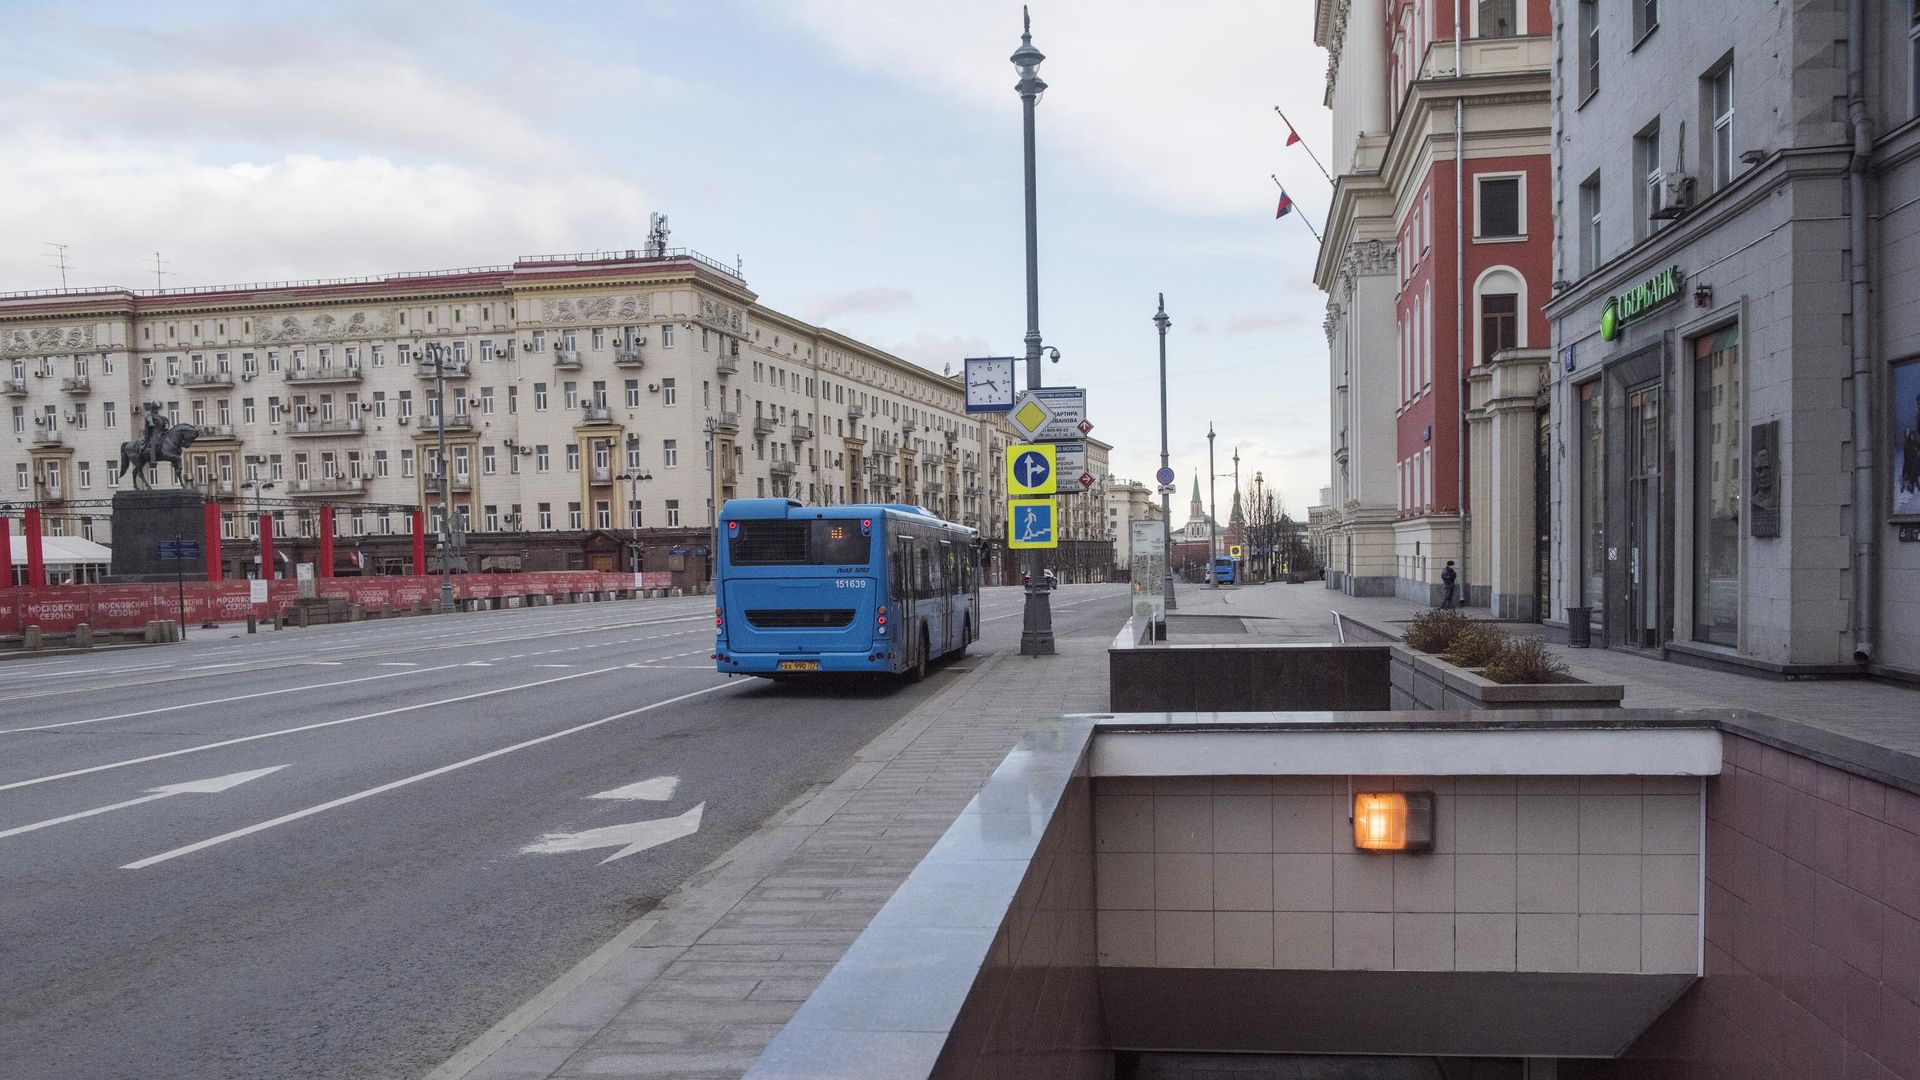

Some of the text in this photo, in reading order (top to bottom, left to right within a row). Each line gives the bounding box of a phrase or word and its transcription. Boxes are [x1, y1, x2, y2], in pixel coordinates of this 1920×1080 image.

[1617, 266, 1677, 320] СБЕРБАНК
[834, 579, 866, 589] 151639
[28, 603, 85, 614] МОСКОВСКИЕ
[98, 600, 149, 610] МОСКОВСКИЕ
[39, 612, 75, 621] СЕЗОНЫ
[108, 608, 141, 617] СЕЗОНЫ
